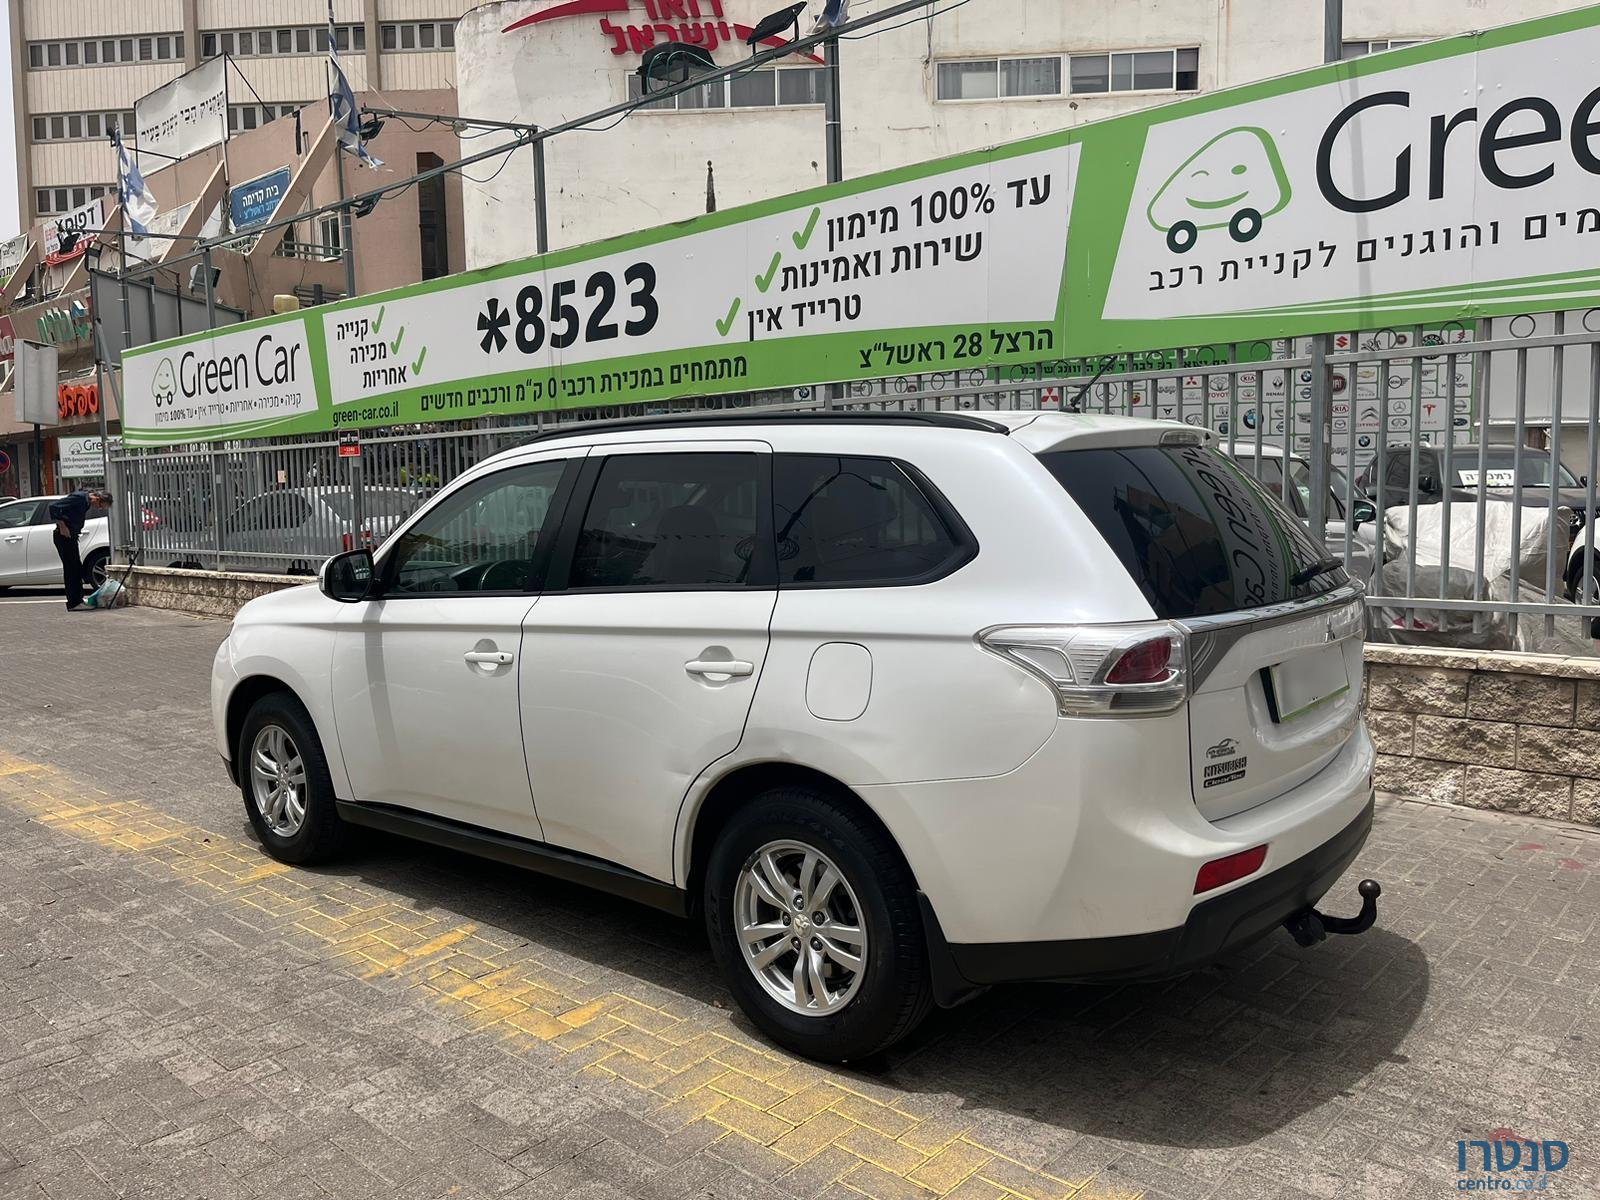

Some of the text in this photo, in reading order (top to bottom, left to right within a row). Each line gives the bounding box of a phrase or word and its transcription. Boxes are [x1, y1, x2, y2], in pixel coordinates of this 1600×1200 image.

[827, 174, 1050, 252] עד 100% מימון
[1357, 220, 1499, 262] והוגנים
[781, 231, 982, 292] שירות ואמינות
[1219, 242, 1336, 282] לקניית
[1149, 264, 1203, 291] רכב
[337, 319, 369, 342] קנייה
[748, 294, 861, 342] טרייד אין
[350, 342, 387, 364] מכירה
[953, 332, 983, 359] 28
[990, 328, 1053, 354] הרצל
[180, 335, 301, 398] Green Car
[362, 366, 407, 388] אחריות
[670, 355, 747, 385] מתמחים
[547, 377, 557, 399] 0
[561, 376, 595, 397] רכבי
[600, 369, 665, 394] במכירת
[258, 396, 279, 409] מכירה
[285, 393, 301, 409] קניה
[420, 391, 463, 411] חדשים
[467, 386, 511, 407] ורכבים
[170, 409, 186, 420] 100%
[333, 401, 400, 427] green-car.co.il
